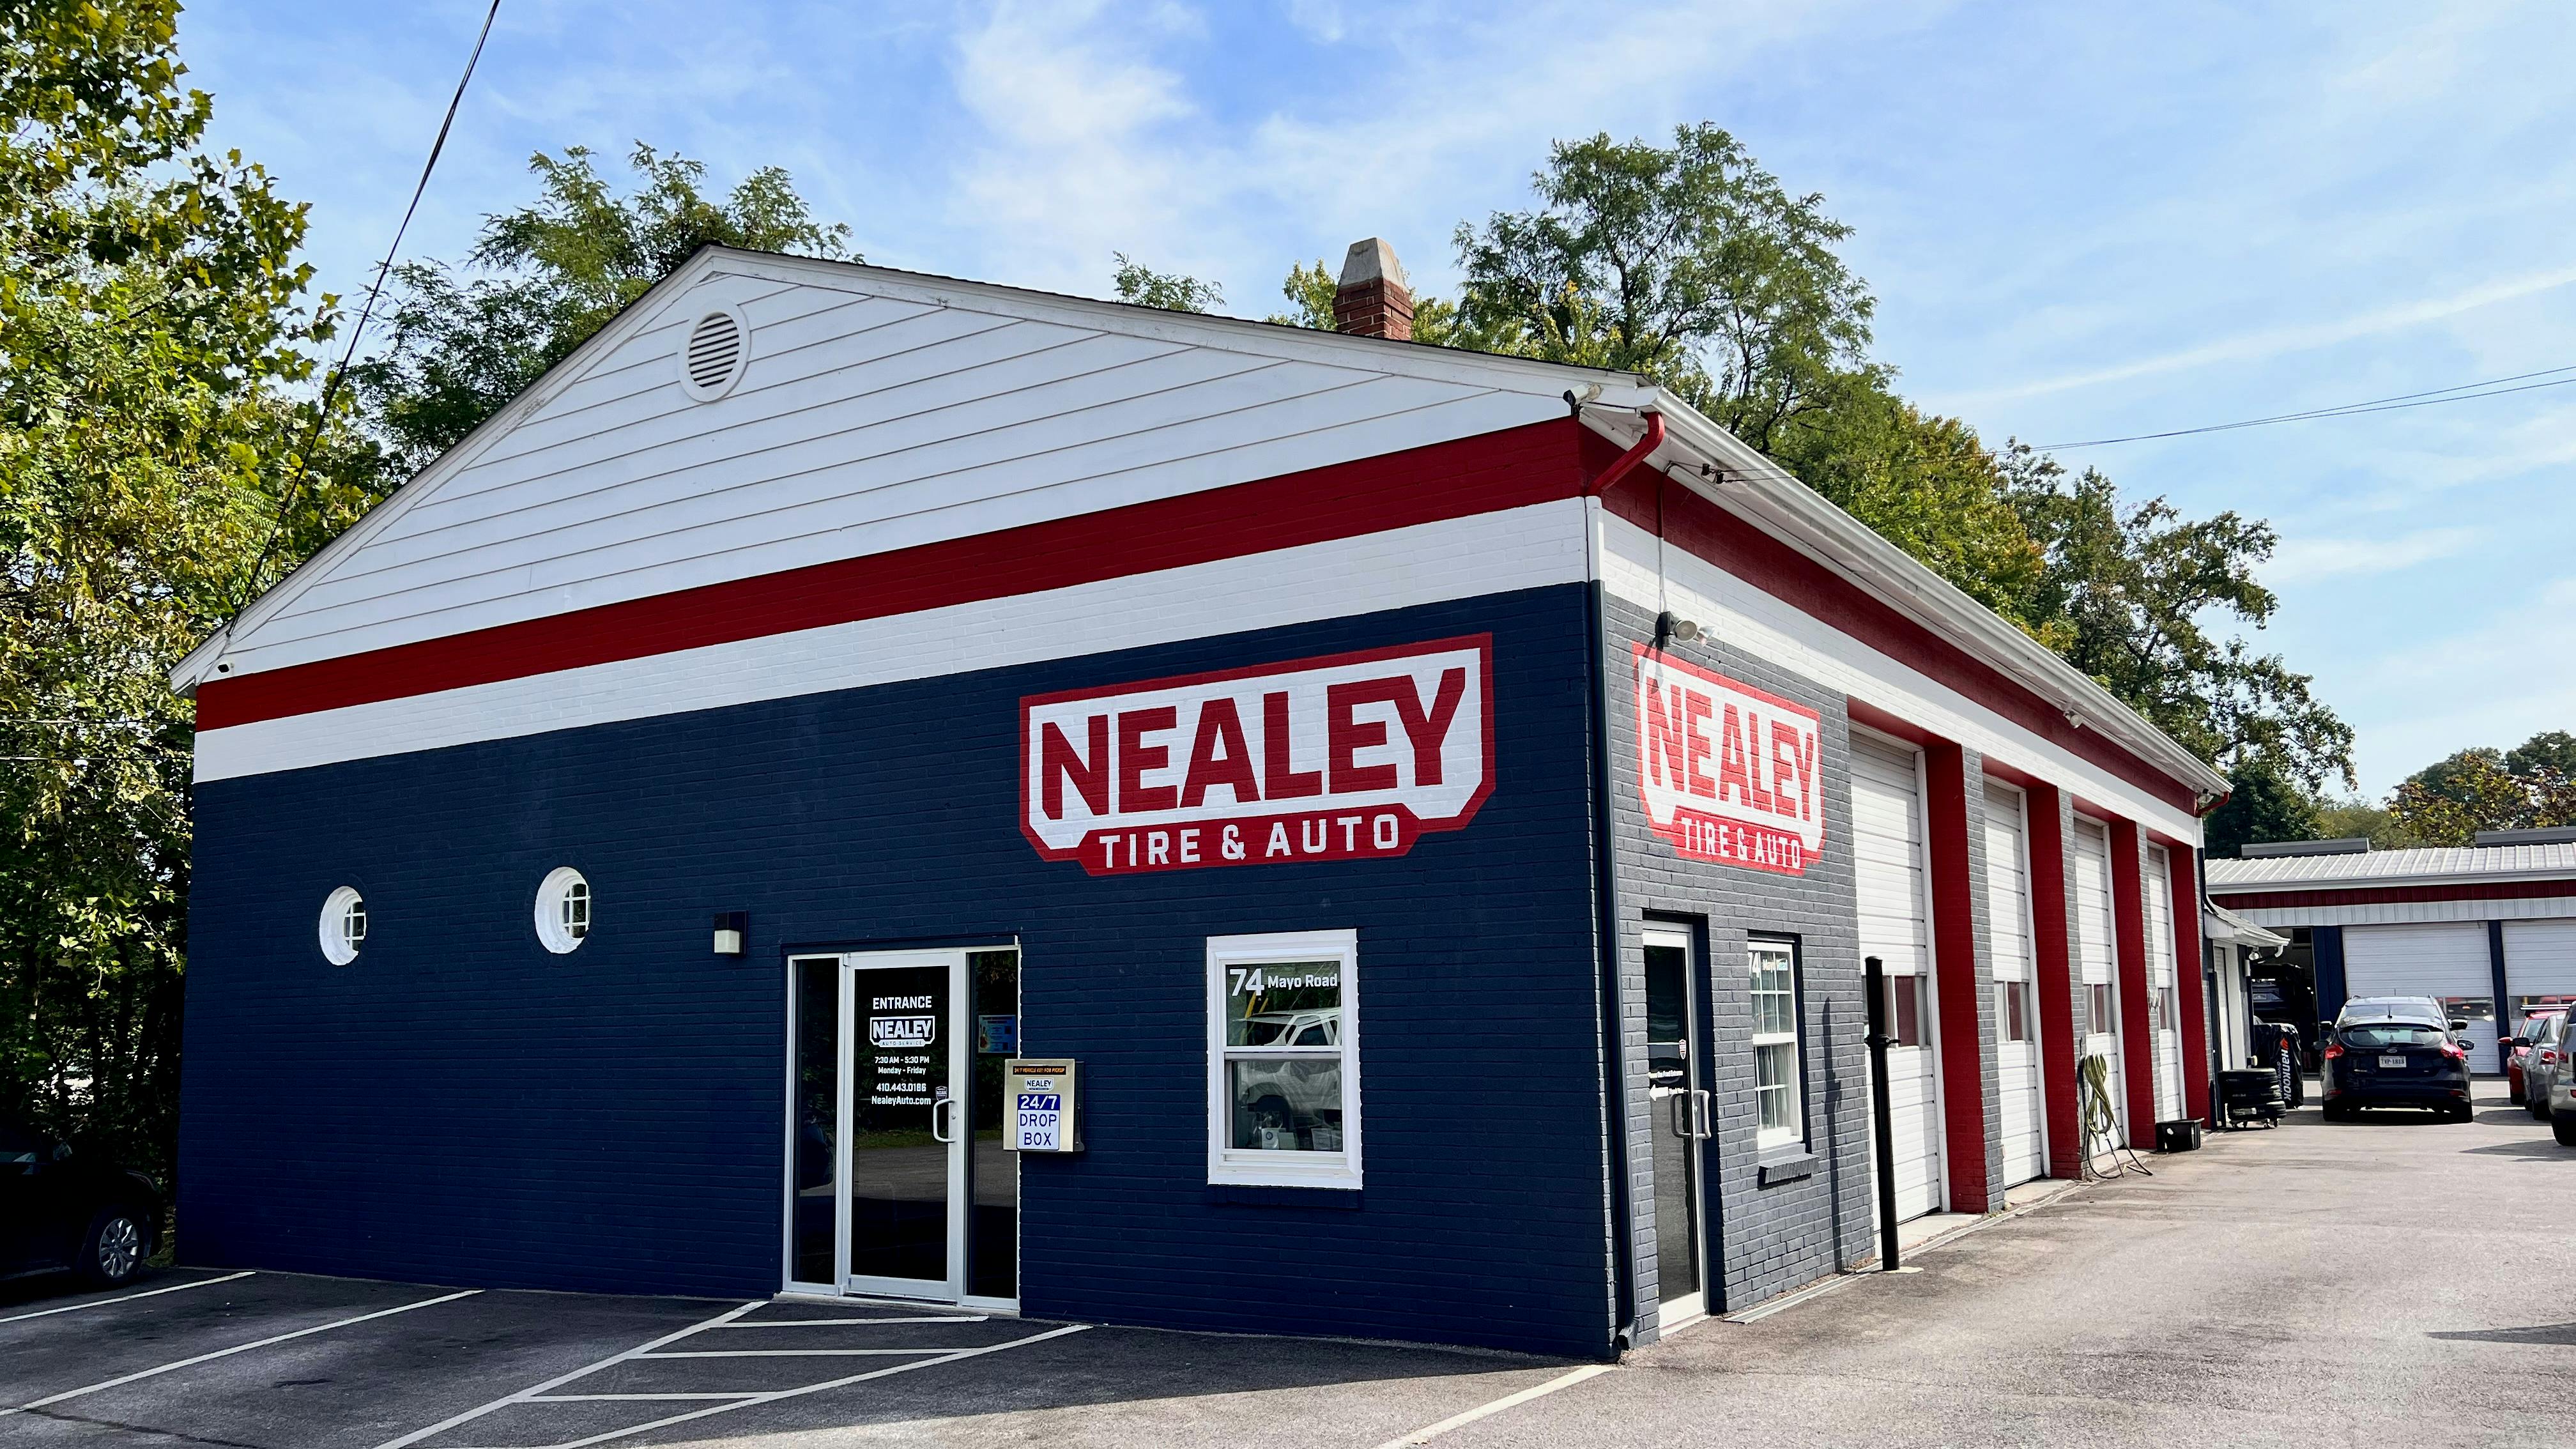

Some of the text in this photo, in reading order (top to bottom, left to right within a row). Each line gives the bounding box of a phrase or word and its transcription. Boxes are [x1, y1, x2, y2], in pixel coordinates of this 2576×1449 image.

[1042, 667, 1466, 820] NEALEY
[1646, 676, 1813, 822] NEALEY
[1100, 813, 1399, 869] TIRE & AUTO
[1681, 817, 1801, 870] TIRE & AUTO
[1230, 968, 1338, 997] 74 Mayo Road
[873, 995, 932, 1010] ENTRANCE
[873, 1020, 931, 1039] NEALEY
[878, 1066, 901, 1075] Monday
[907, 1066, 926, 1075] Friday
[871, 1095, 931, 1106] NealeyAuto.com
[1020, 1095, 1057, 1110] 24/7
[1020, 1114, 1057, 1127] DROP
[1023, 1132, 1052, 1146] BOX
